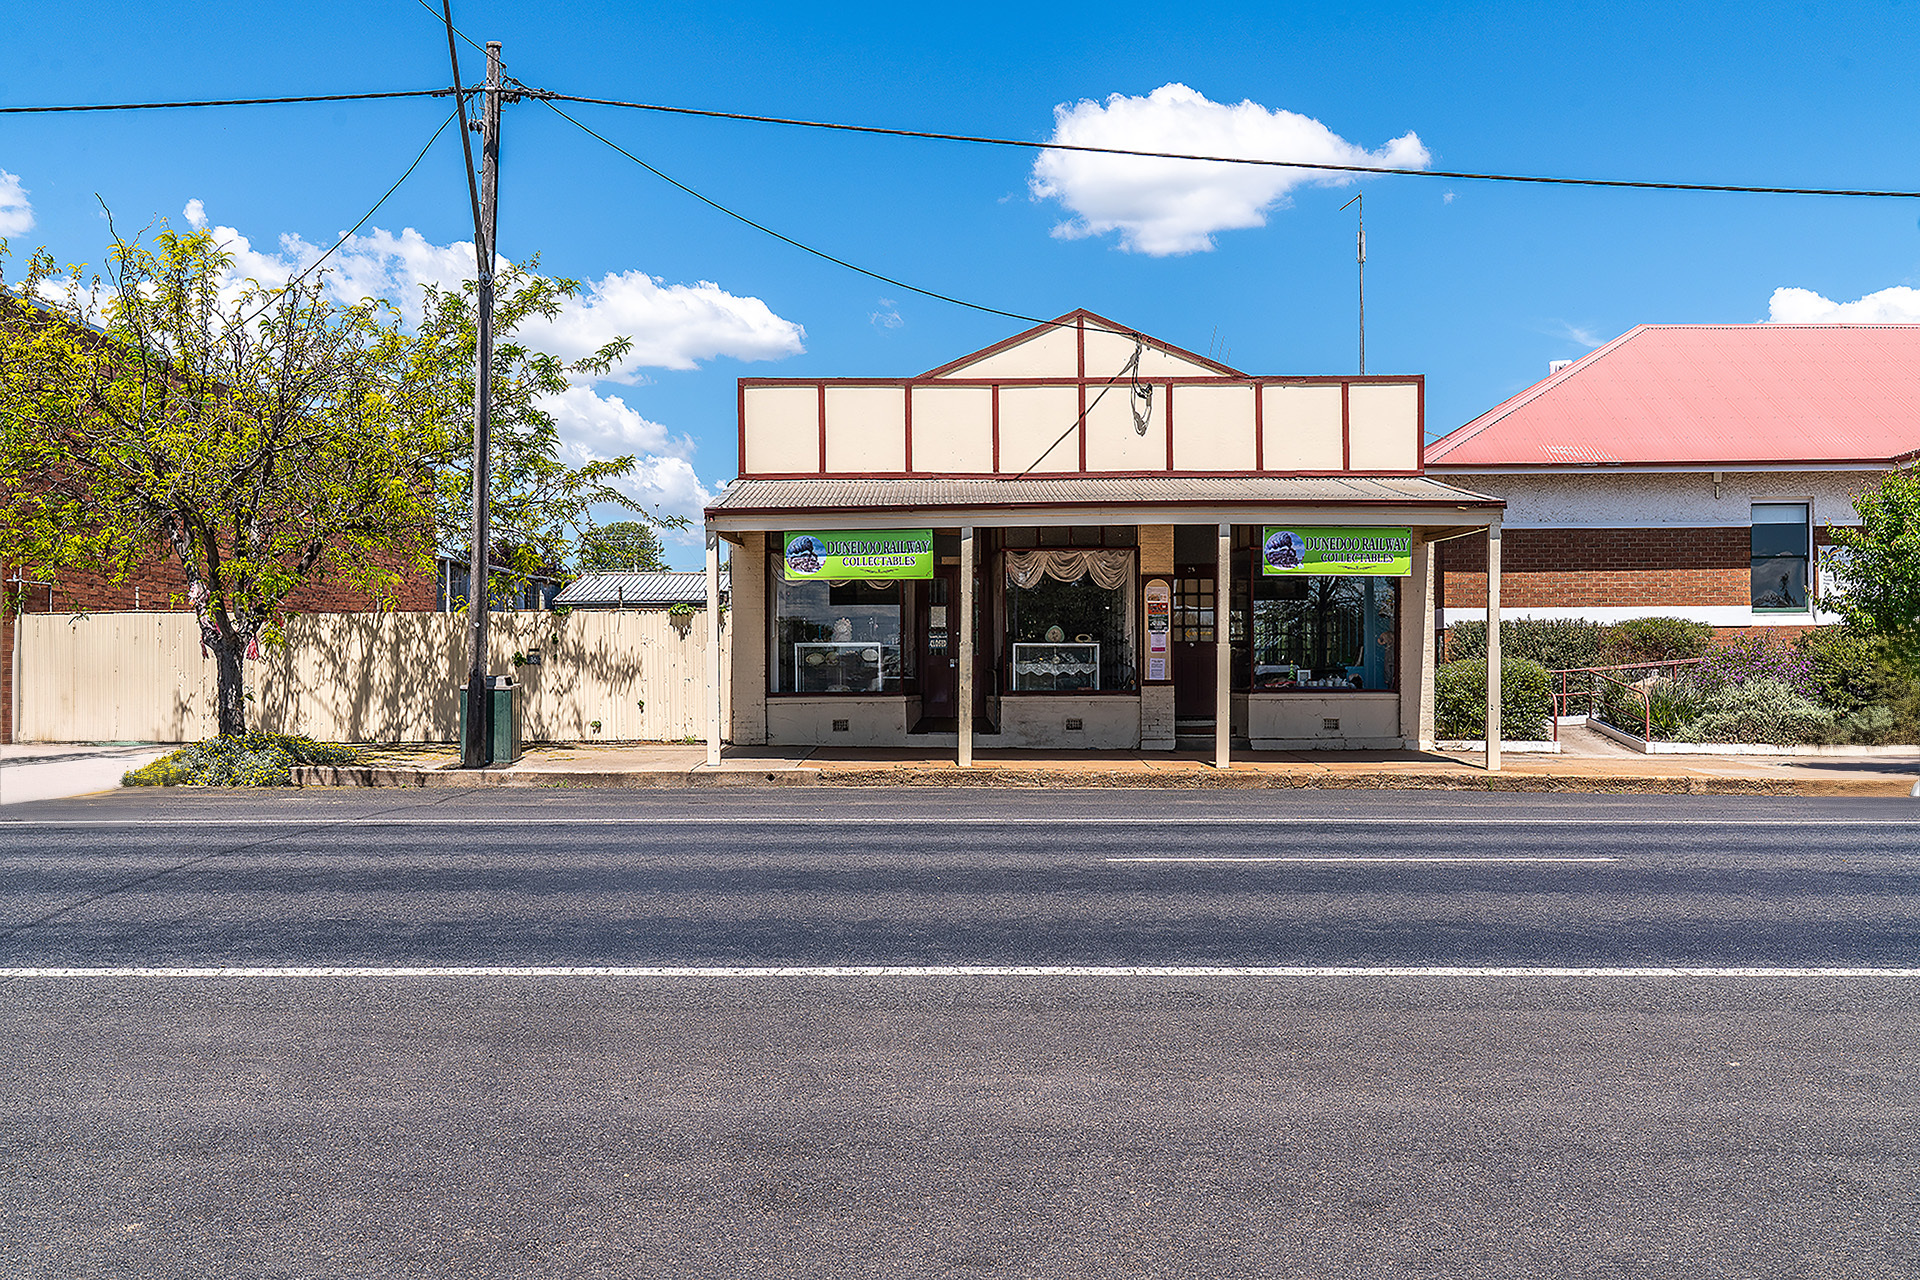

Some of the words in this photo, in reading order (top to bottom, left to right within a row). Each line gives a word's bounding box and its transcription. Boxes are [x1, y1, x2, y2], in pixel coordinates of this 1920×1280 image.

[827, 541, 881, 555] DUNEDOO
[883, 540, 930, 554] RAILWAY
[1305, 537, 1360, 551] DUNEDOO
[1361, 537, 1409, 551] RAILWAY
[842, 556, 916, 567] COLLECTABLES
[1320, 553, 1394, 563] COLLECTABLES
